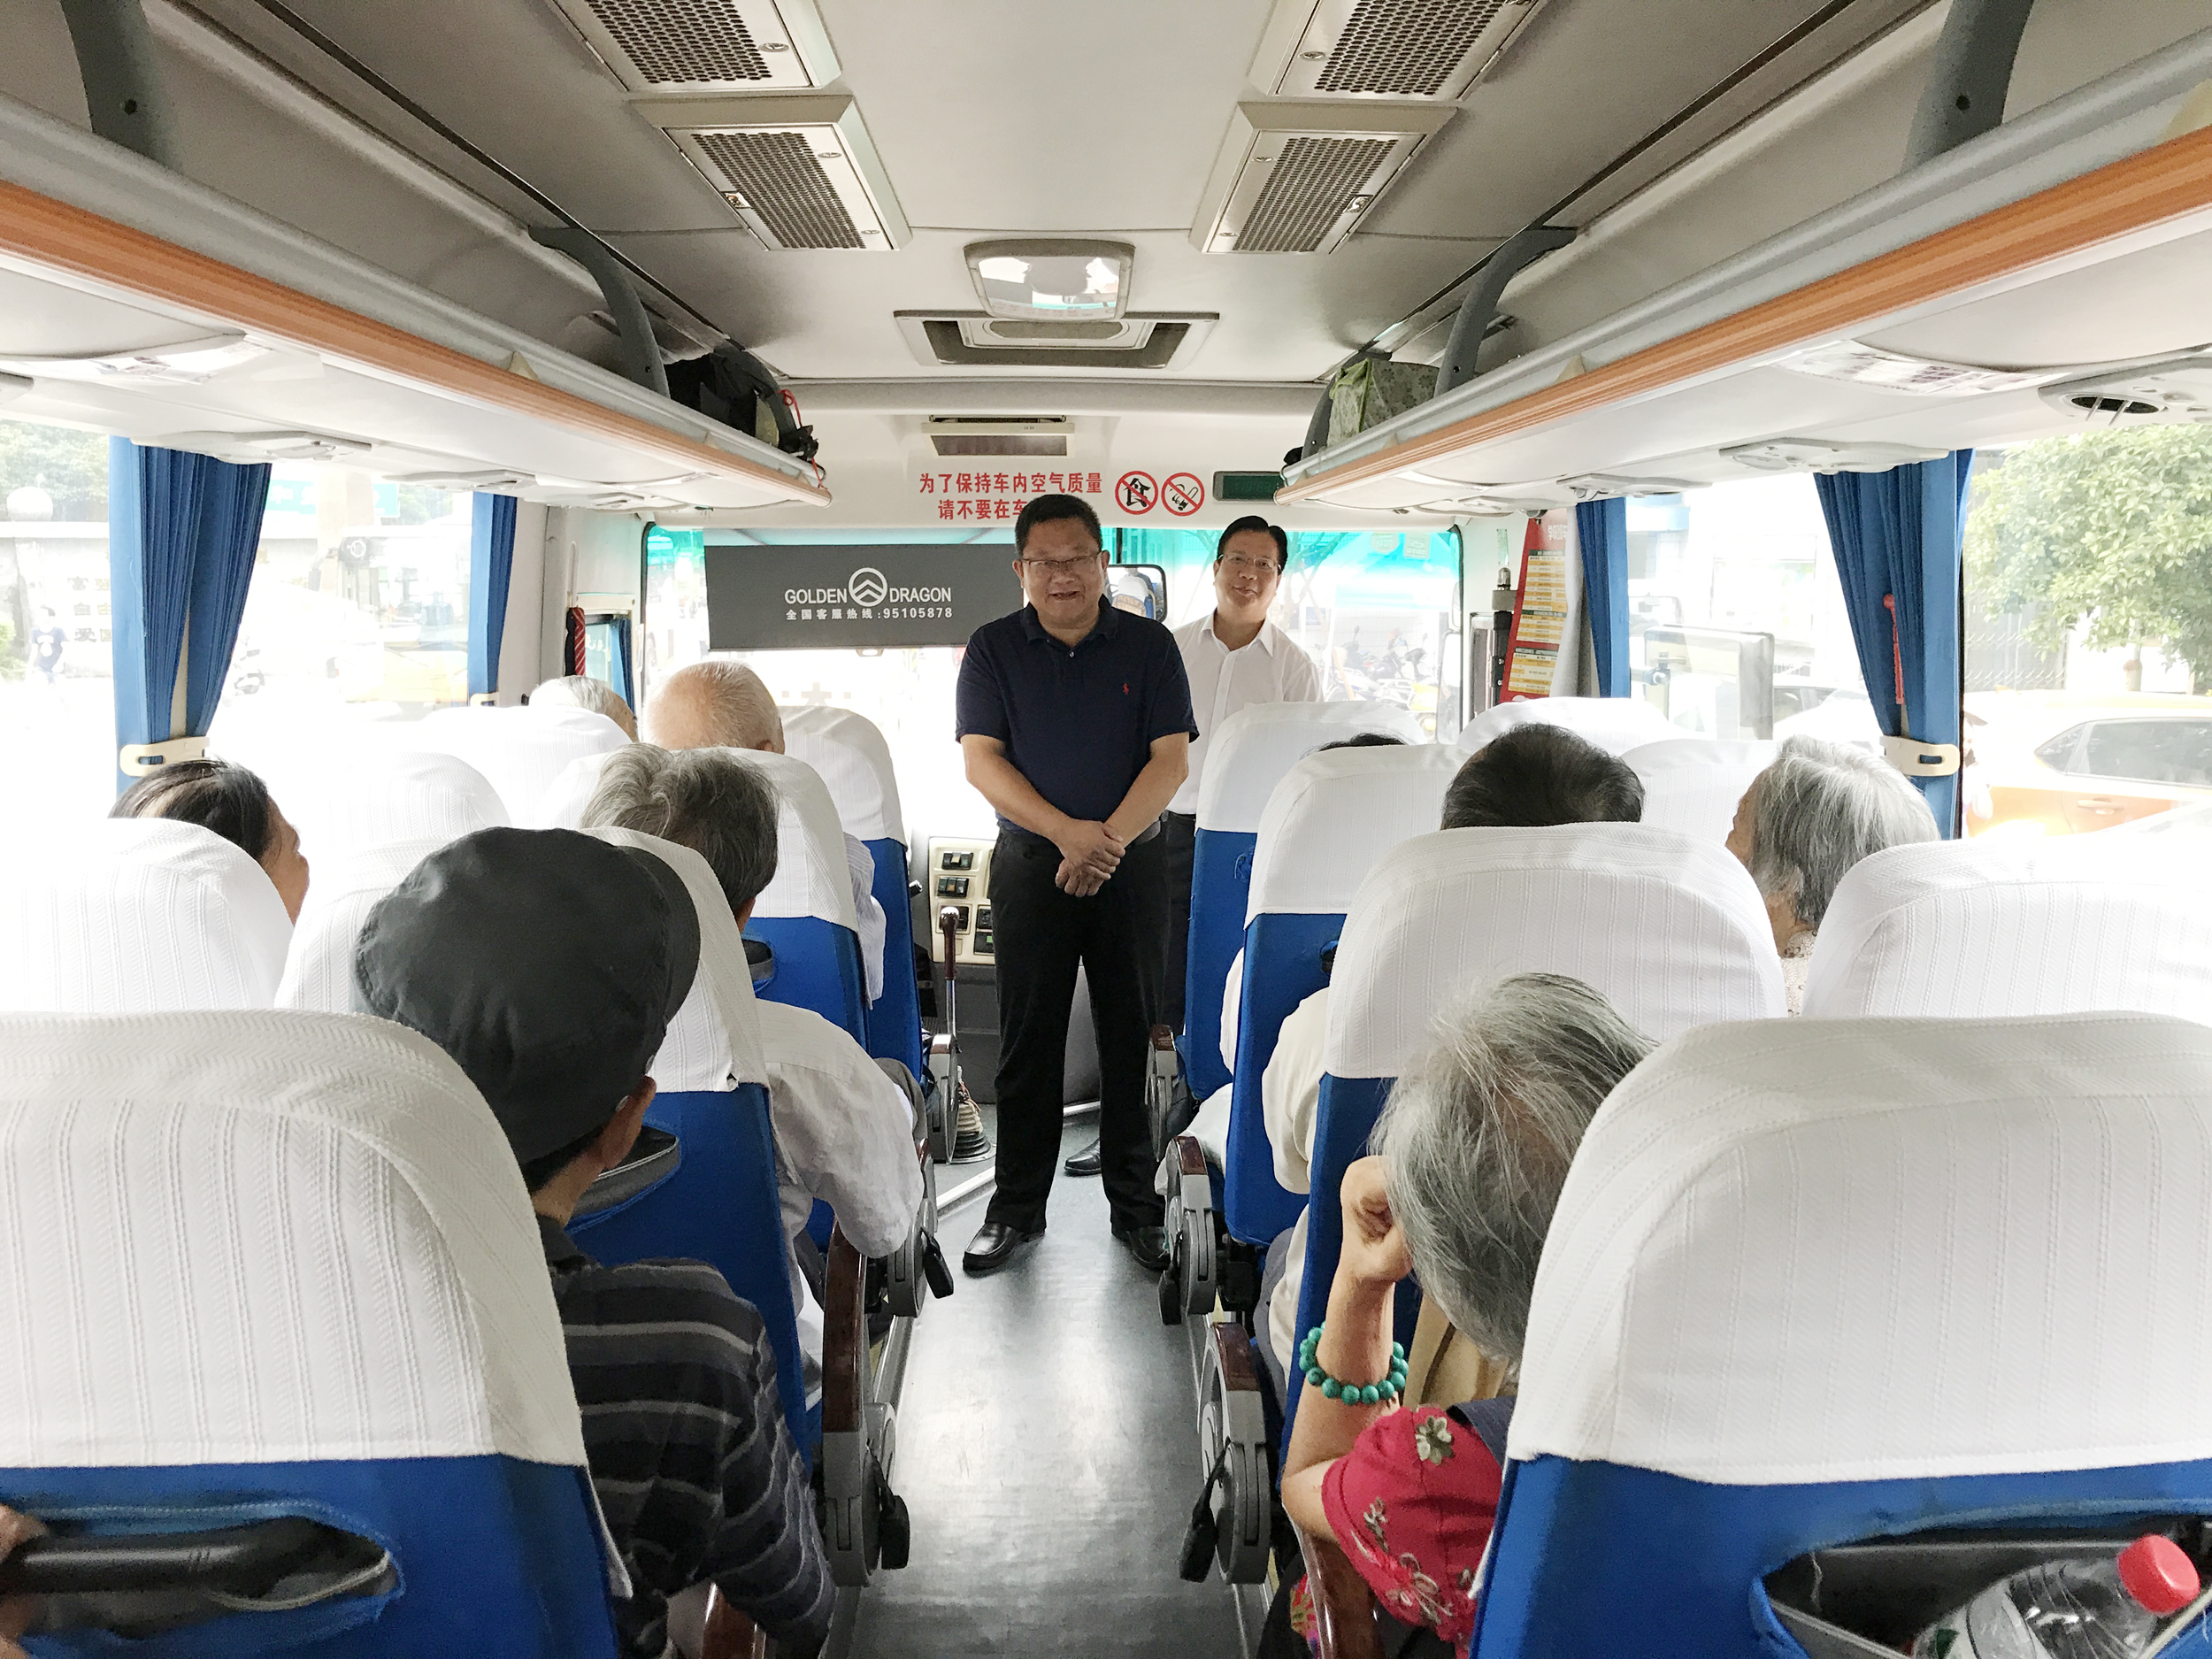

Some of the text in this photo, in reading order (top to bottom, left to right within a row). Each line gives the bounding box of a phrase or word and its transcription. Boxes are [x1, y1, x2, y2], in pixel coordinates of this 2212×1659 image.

[919, 472, 1102, 494] 为了保持车内空气质量
[784, 588, 952, 604] GOLDEN DRAGON
